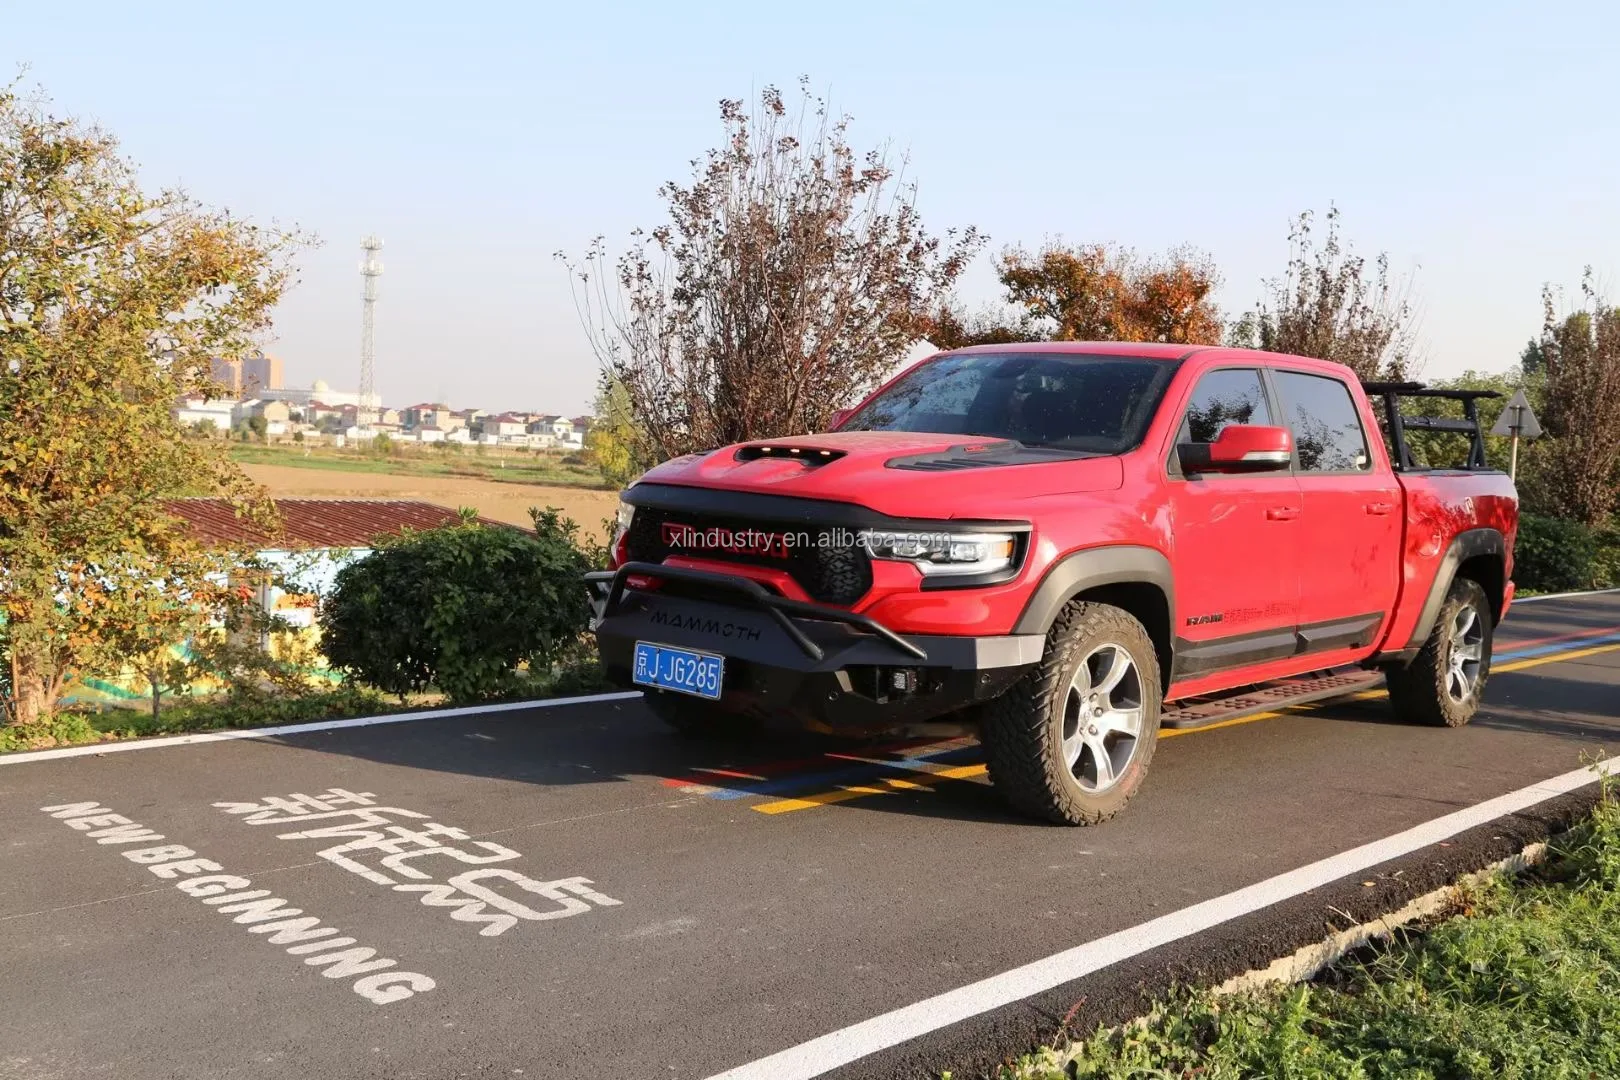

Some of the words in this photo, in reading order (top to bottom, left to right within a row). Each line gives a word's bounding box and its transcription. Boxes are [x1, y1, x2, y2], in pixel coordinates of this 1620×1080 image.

[650, 611, 763, 641] MAMMOTH
[1186, 613, 1224, 627] RAM
[39, 801, 166, 845] NEW
[121, 844, 437, 1005] BEGINNING
[211, 788, 624, 937] 新起点
